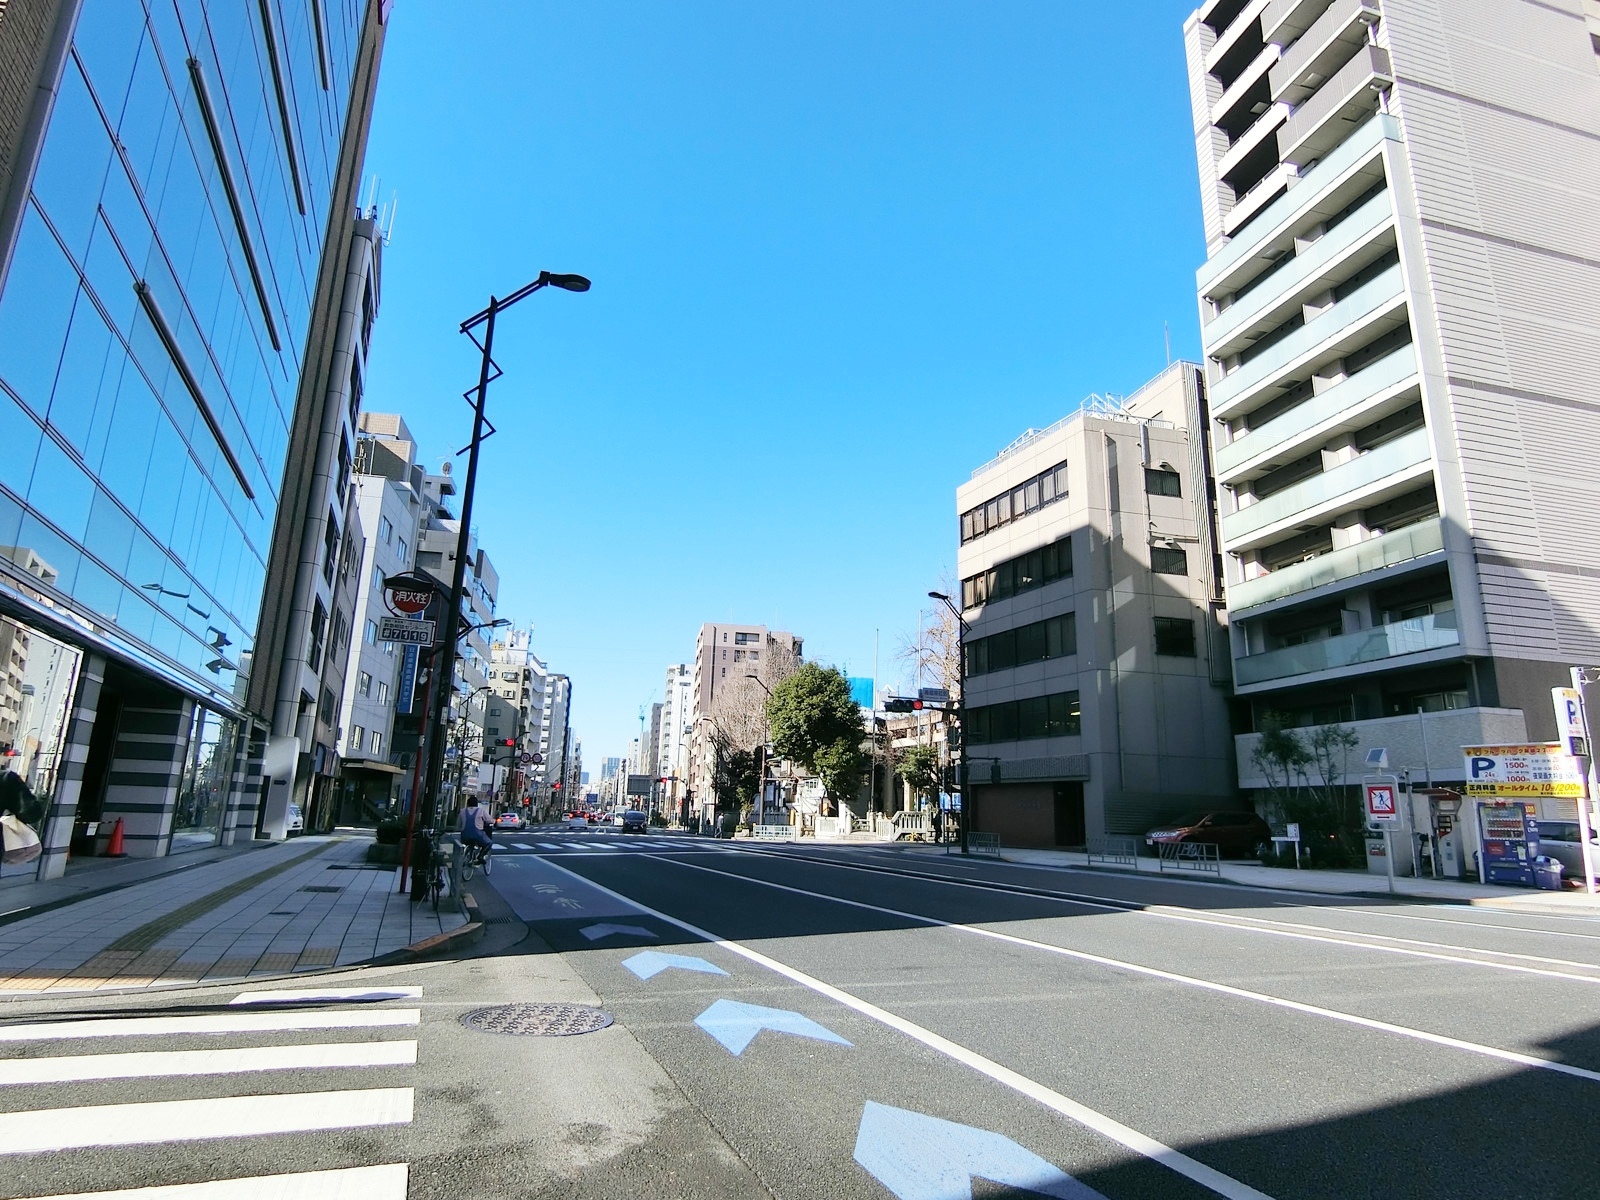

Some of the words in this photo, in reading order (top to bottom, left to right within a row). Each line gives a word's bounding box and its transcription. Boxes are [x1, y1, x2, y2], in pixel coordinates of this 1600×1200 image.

[395, 591, 428, 604] 消火栓
[383, 629, 427, 641] #7119
[1566, 699, 1577, 725] P
[1471, 757, 1496, 778] P
